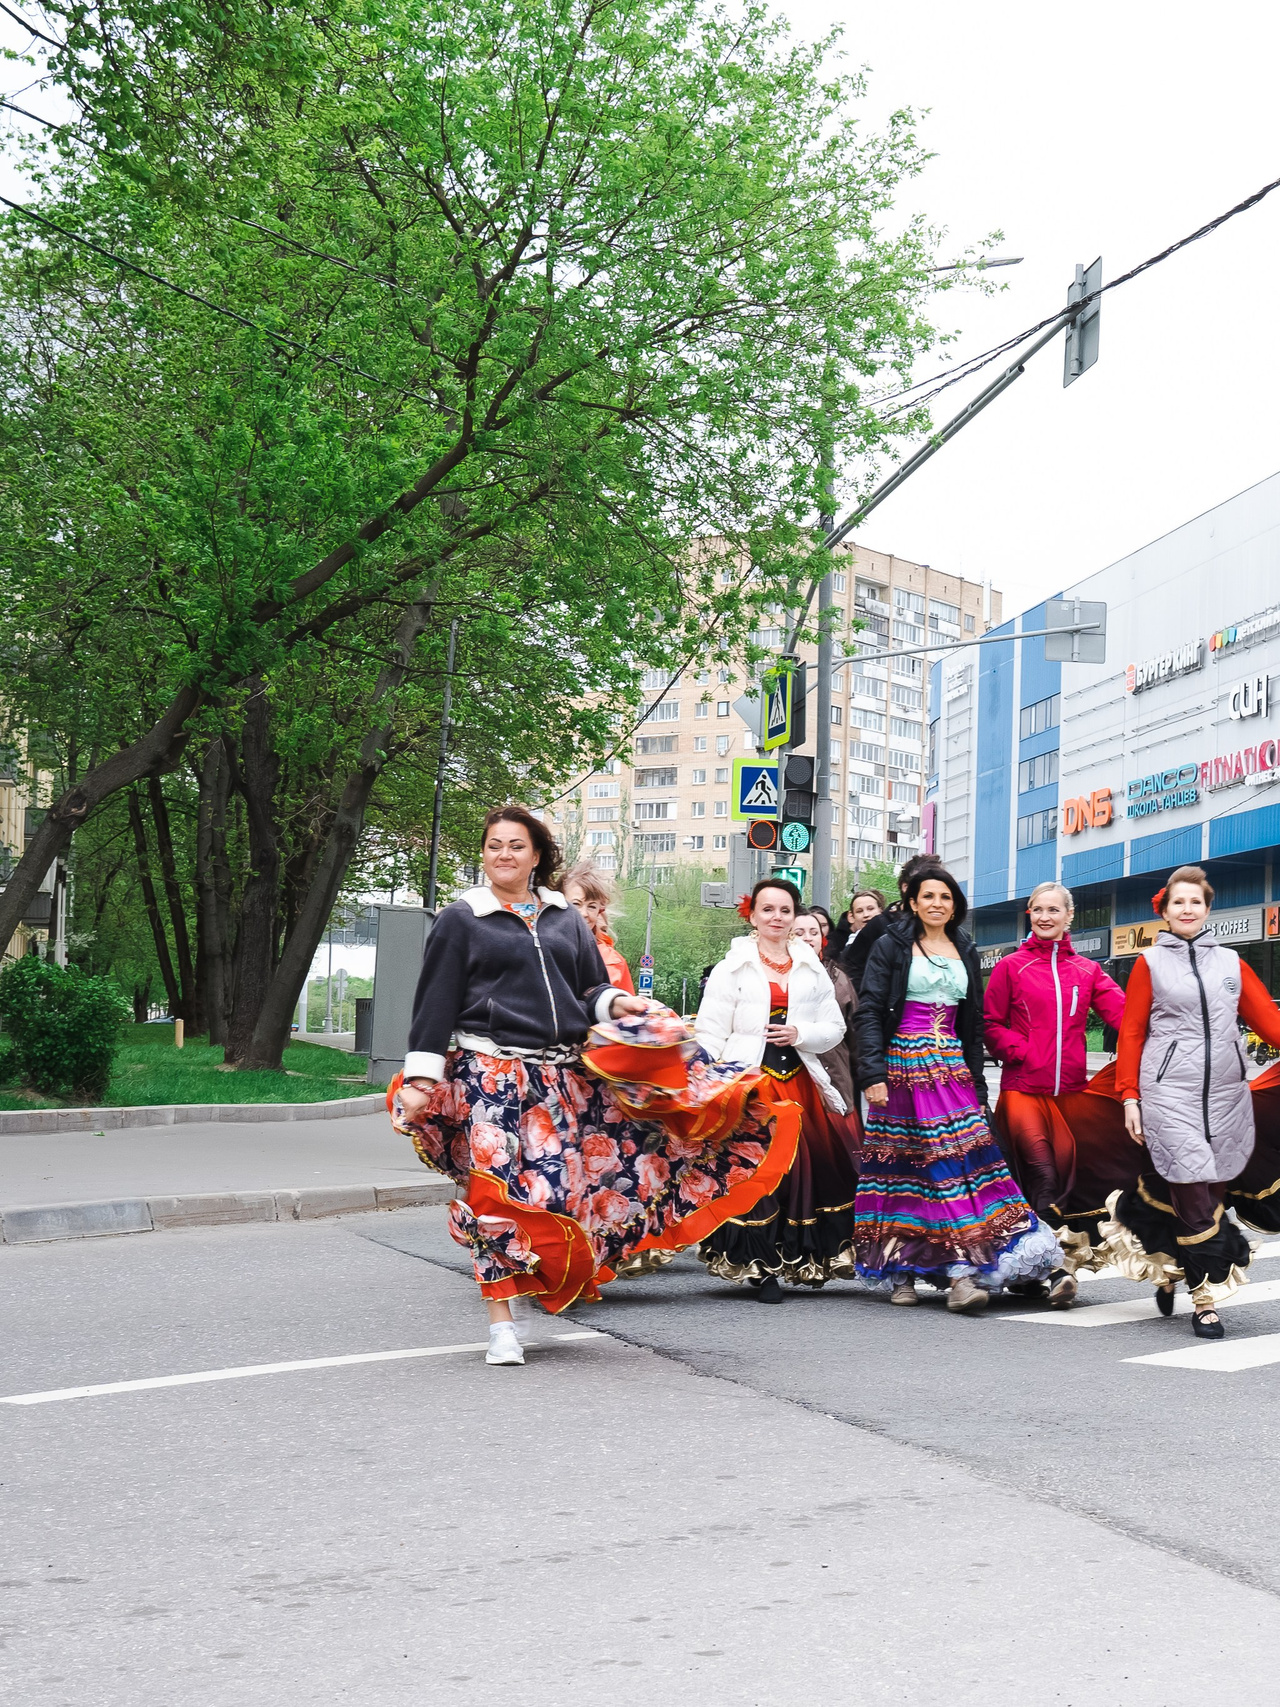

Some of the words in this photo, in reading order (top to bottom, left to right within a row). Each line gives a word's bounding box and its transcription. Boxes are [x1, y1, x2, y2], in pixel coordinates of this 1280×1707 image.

[1136, 652, 1172, 687] БУРГЕР
[1172, 640, 1201, 672] КИНГ
[1127, 762, 1199, 800] DANCO
[1063, 787, 1112, 835] DNS
[1127, 800, 1158, 819] ШКОЛА
[1159, 788, 1198, 811] ТАНЦЕВ
[1219, 919, 1250, 936] COFFEE
